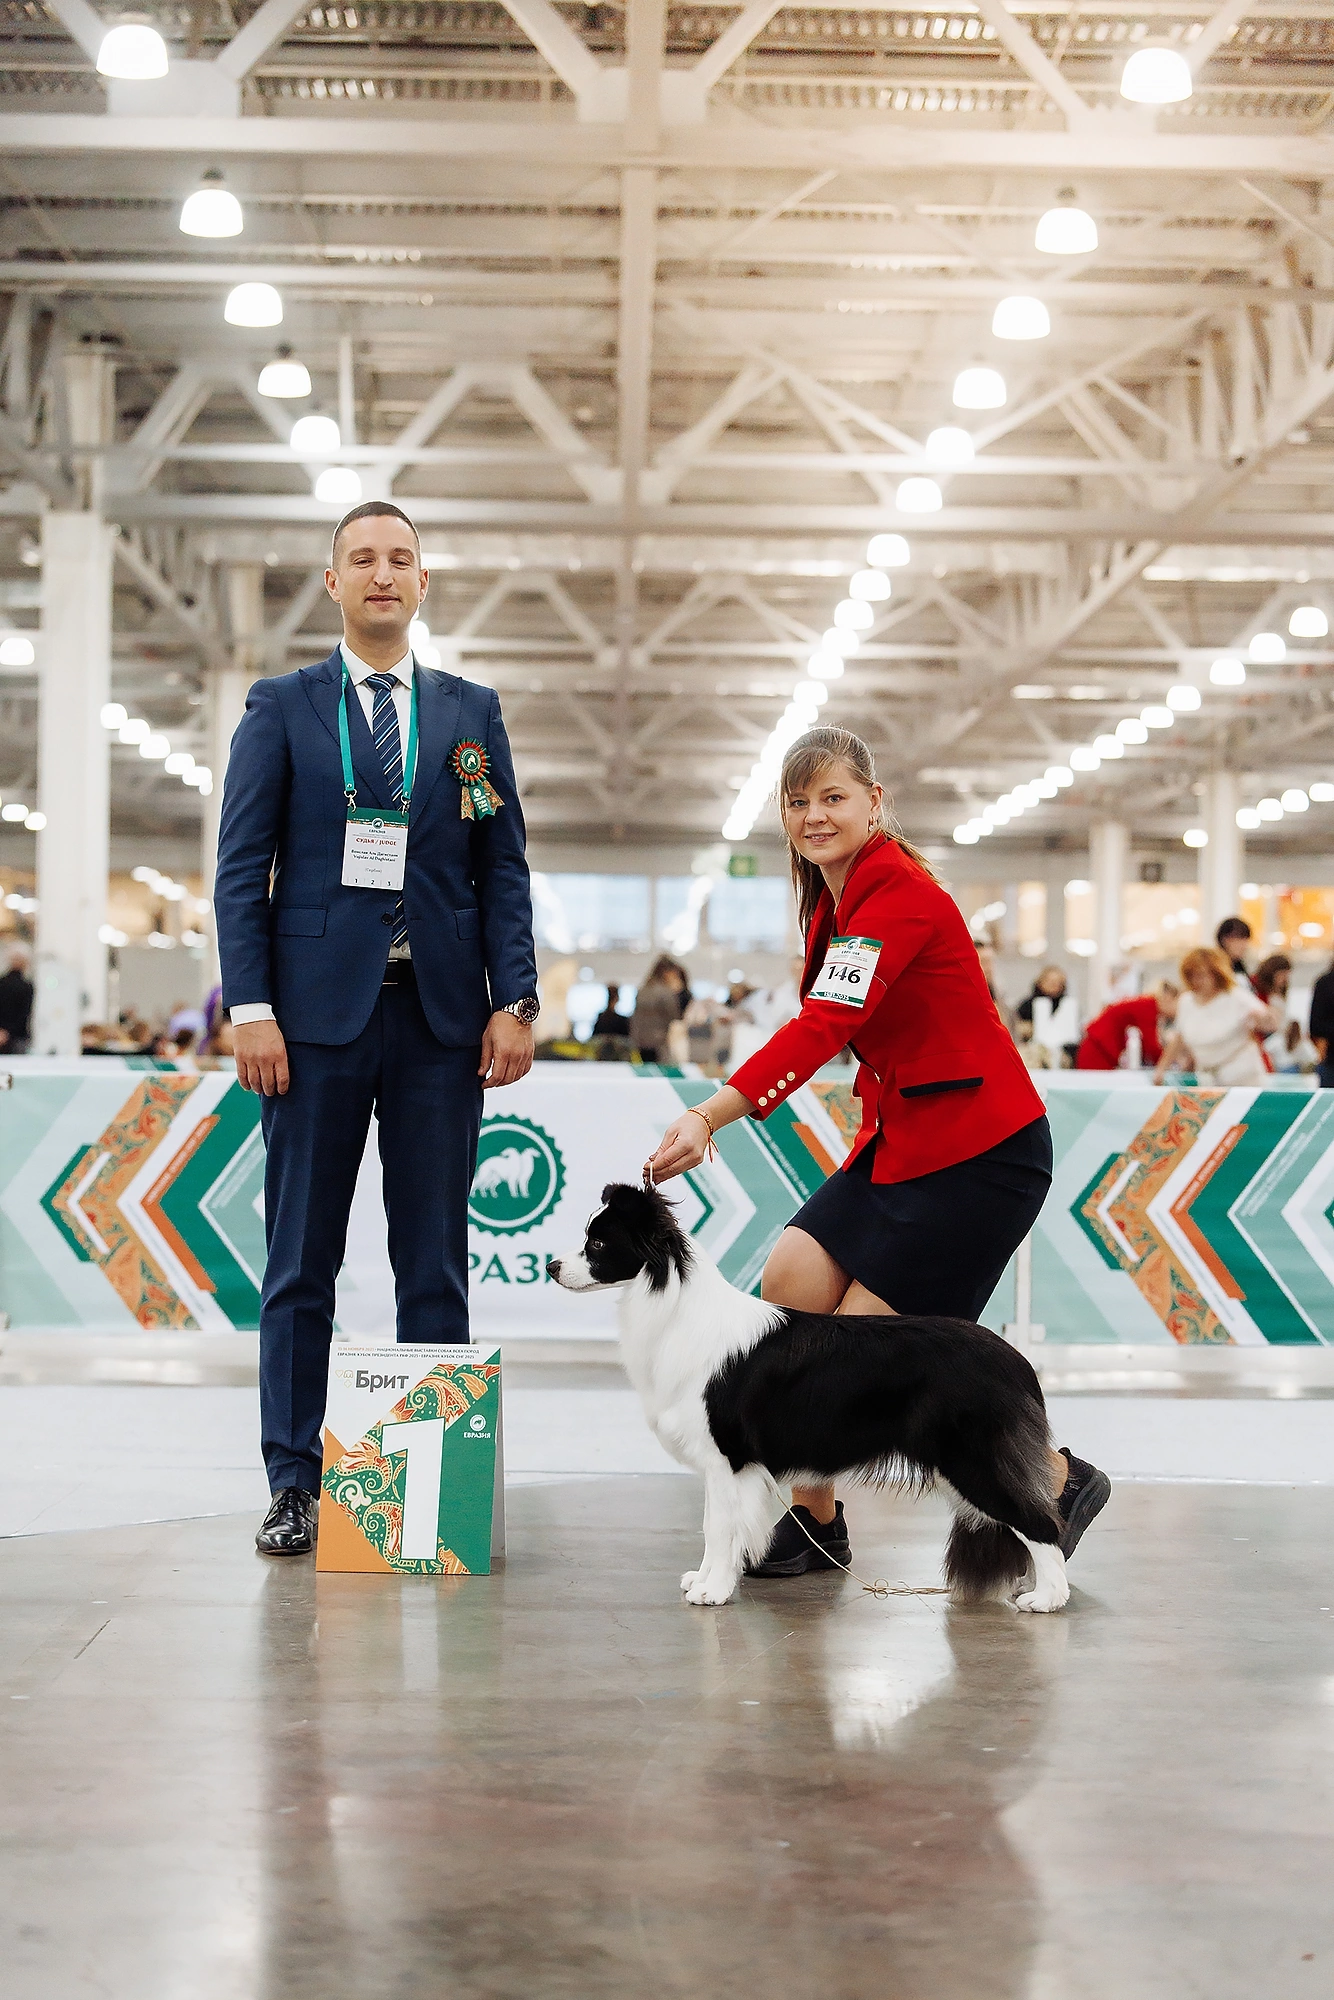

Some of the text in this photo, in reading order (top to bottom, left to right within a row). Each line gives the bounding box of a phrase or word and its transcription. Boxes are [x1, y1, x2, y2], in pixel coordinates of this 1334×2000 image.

[828, 965, 861, 984] 146
[356, 1370, 409, 1393] Брит
[463, 1431, 491, 1439] ЕВРАЗИЯ
[381, 1416, 446, 1560] 1
